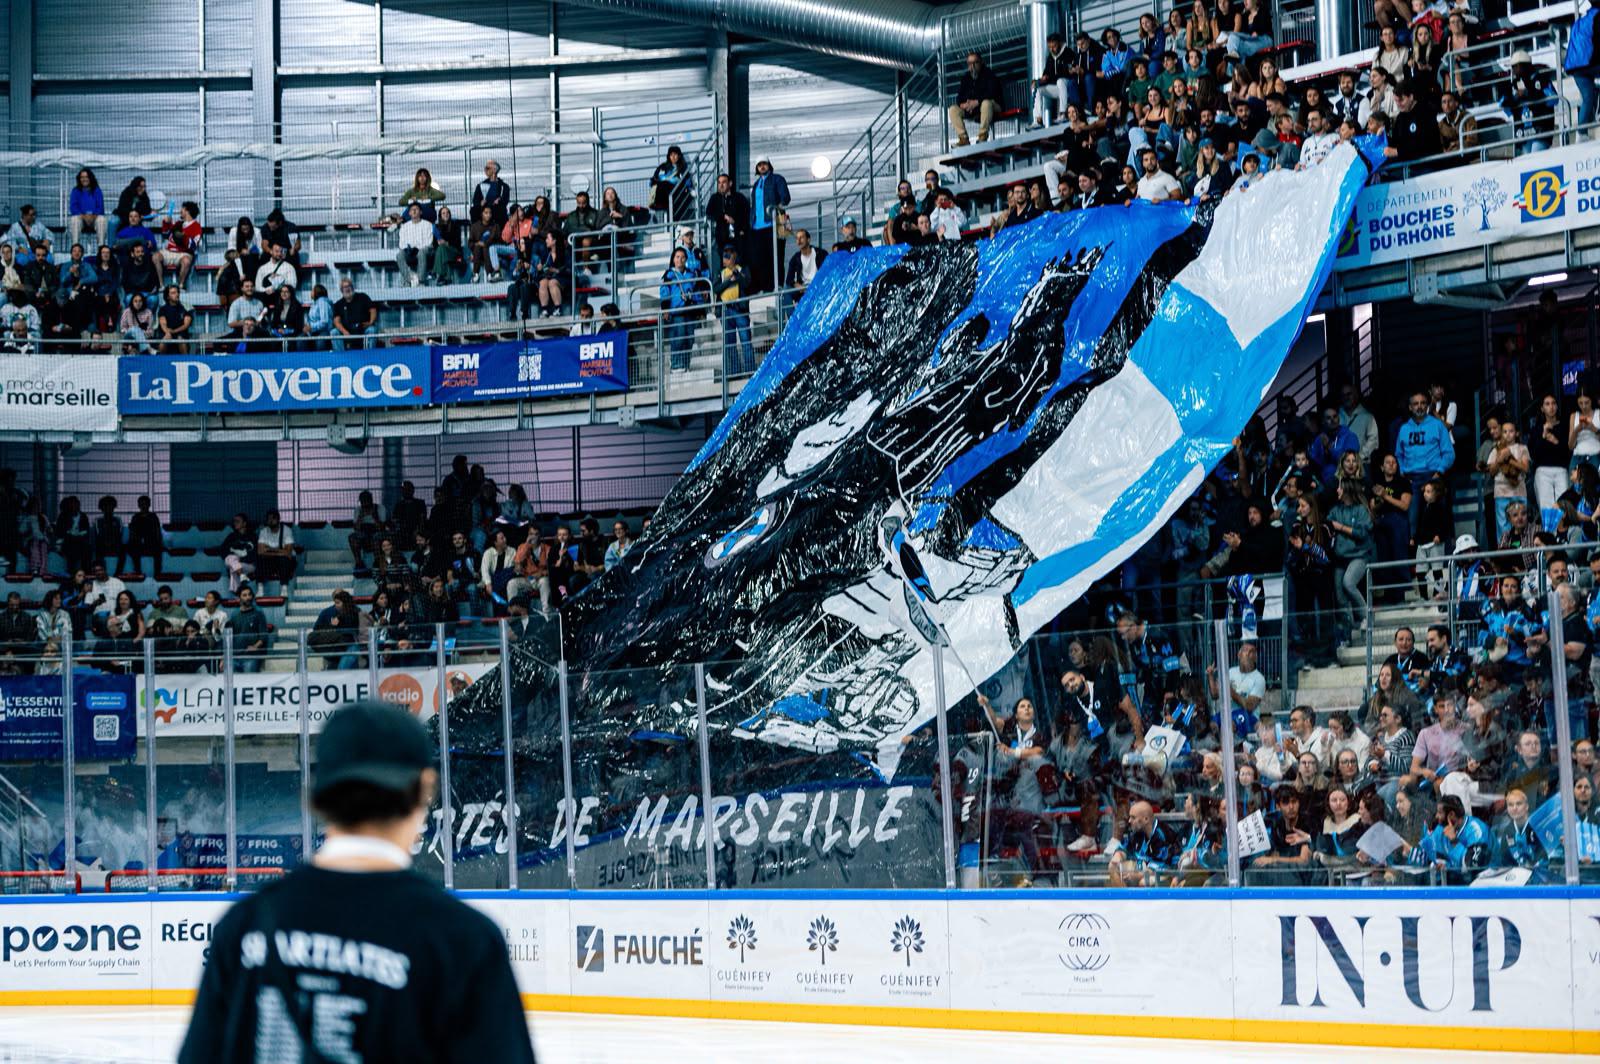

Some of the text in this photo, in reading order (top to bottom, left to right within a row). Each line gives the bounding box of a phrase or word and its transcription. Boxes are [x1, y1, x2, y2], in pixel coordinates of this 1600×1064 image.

[1531, 176, 1557, 213] 13
[580, 341, 613, 360] BFM
[443, 353, 479, 371] BFM
[6, 376, 74, 391] made in
[7, 388, 110, 406] marseille
[382, 688, 420, 703] radio
[6, 707, 64, 718] MARSEILL
[549, 796, 600, 849] DE
[624, 785, 913, 853] MARSEILLE
[248, 839, 278, 849] FFHG
[253, 855, 284, 865] FFHG
[161, 918, 213, 942] RÉGI
[614, 928, 703, 965] FAUCHÉ
[1068, 937, 1100, 947] CIRCA
[14, 958, 140, 969] Let's Perform Your Supply Chain
[717, 969, 771, 982] GUÉNIFEY
[796, 970, 853, 985] GUÉNIFEY
[880, 972, 940, 987] GUÉNIFEY
